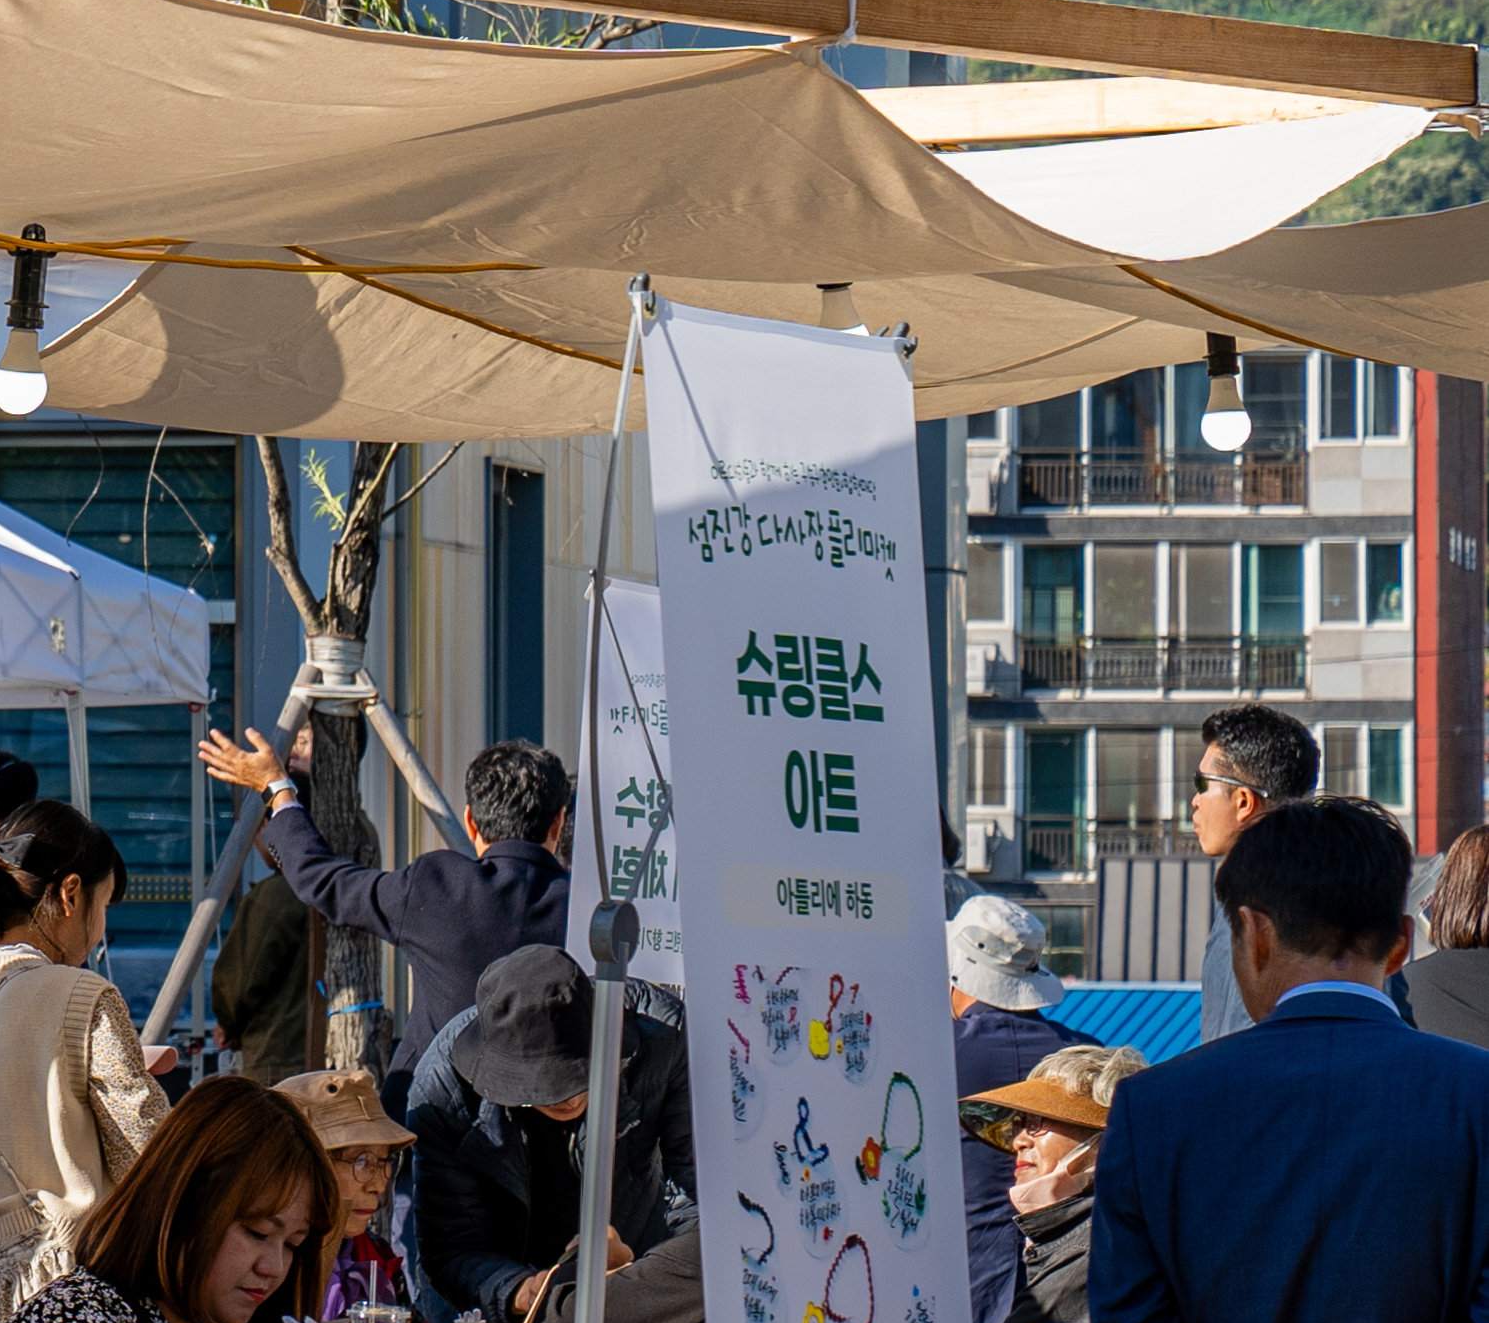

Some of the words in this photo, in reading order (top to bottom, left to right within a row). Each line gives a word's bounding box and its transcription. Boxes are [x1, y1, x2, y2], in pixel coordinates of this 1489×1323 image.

[689, 502, 751, 563] 섬진강
[757, 510, 823, 561] 다사장
[828, 509, 897, 582] 플리마켓
[736, 629, 885, 723] 슈링클스
[785, 749, 860, 834] 아트
[777, 879, 841, 918] 아틀리에
[845, 881, 874, 921] 하동
